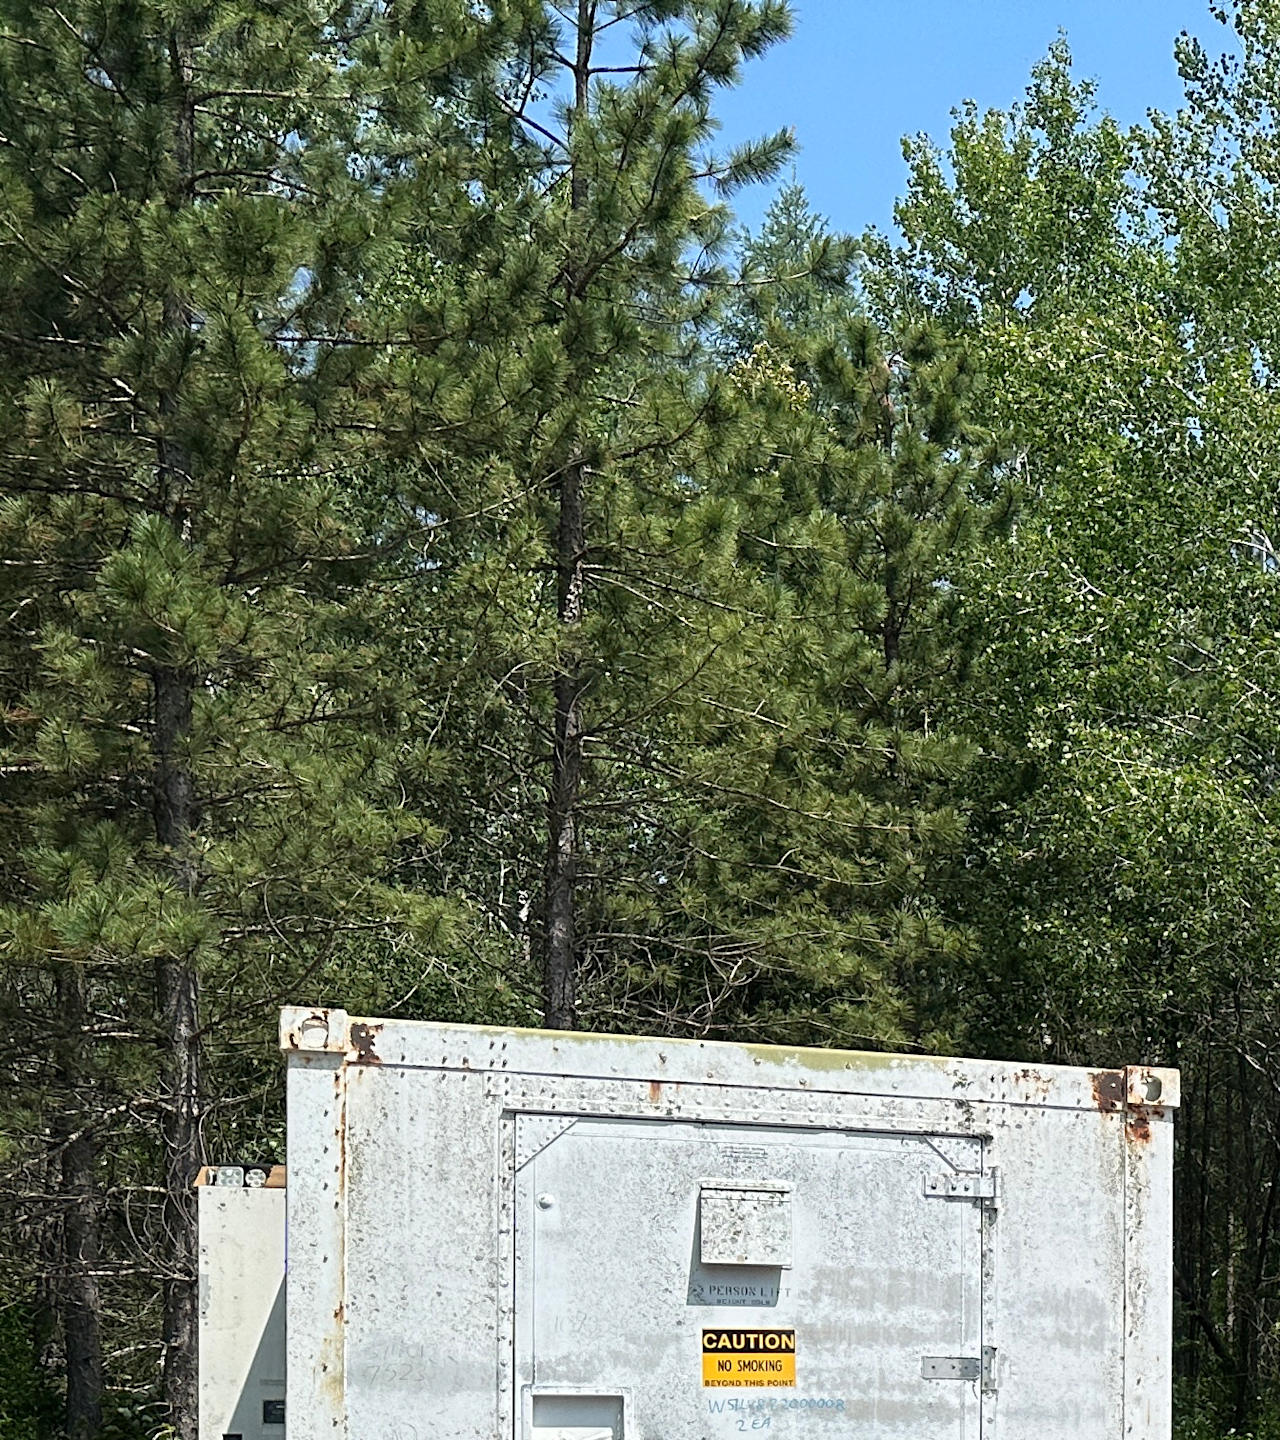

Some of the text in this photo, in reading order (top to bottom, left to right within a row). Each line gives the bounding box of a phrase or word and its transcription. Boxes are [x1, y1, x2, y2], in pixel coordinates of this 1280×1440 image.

[709, 1285, 757, 1297] PERSON
[703, 1333, 795, 1350] CAUTION
[717, 1359, 783, 1372] NO SMOKING
[704, 1379, 794, 1387] BEYOND THIS POINT
[736, 1417, 771, 1431] 2 EA
